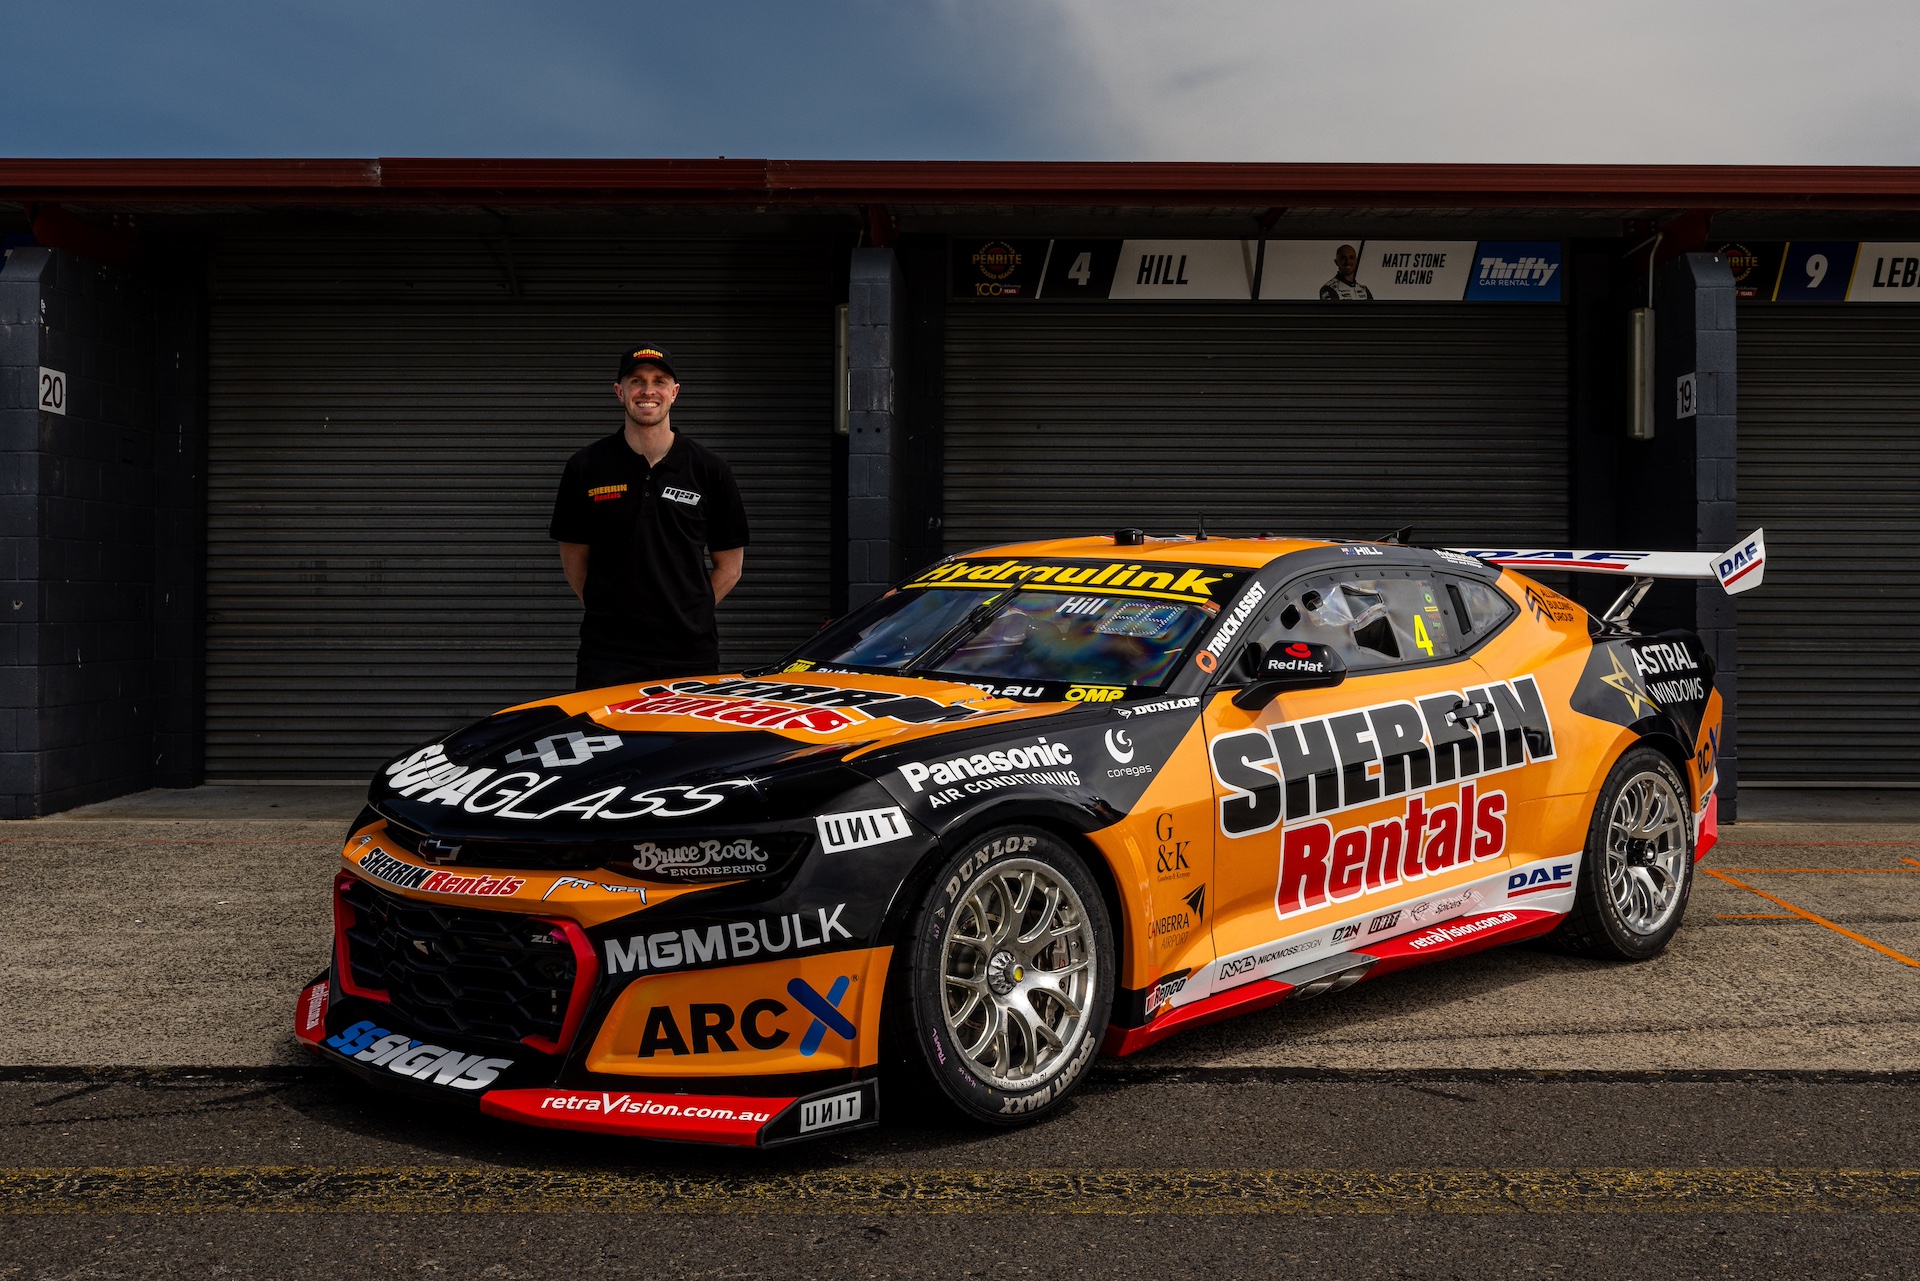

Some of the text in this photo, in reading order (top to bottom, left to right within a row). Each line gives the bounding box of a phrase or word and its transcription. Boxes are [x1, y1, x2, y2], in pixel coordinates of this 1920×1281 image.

[972, 254, 1022, 265] PENRITE
[1067, 252, 1092, 286] 4
[1137, 255, 1188, 285] HILL
[1382, 254, 1446, 268] MATT STONE
[1479, 257, 1559, 287] Thrifty
[1728, 256, 1758, 267] RITE
[1806, 253, 1829, 289] 9
[1873, 257, 1920, 288] LEB
[975, 283, 1002, 296] 100
[1395, 270, 1433, 285] RACING
[42, 374, 63, 409] 20
[1679, 380, 1692, 414] 19
[588, 484, 628, 497] SHERRIN
[1354, 546, 1383, 556] HILL
[1719, 542, 1758, 578] DAF
[915, 560, 1223, 597] Hydraulink
[1055, 597, 1109, 615] Hill
[1413, 614, 1435, 657] 4
[1268, 660, 1324, 672] Red Hat
[1631, 642, 1698, 677] ASTRAL
[1065, 688, 1125, 702] OMP
[1132, 696, 1200, 715] DUNLOP
[1646, 677, 1705, 704] WINDOWS
[898, 737, 1073, 792] Panasonic
[1211, 674, 1556, 838] SHERRIN
[386, 744, 748, 820] SUPAGLASS
[1107, 765, 1152, 778] coregas
[928, 770, 1081, 809] AIR CONDITIONING
[824, 812, 899, 847] UNIT
[1156, 812, 1174, 842] G
[632, 839, 769, 870] Bruce Rock
[1276, 781, 1508, 919] Rentals
[358, 847, 526, 896] SHERRIN Rentals
[670, 864, 767, 877] ENGINEERING
[946, 836, 1038, 904] DUNLOP
[1508, 864, 1573, 890] DAF
[604, 903, 852, 974] MGMBULK
[1148, 912, 1190, 939] CANBERRA
[1160, 931, 1190, 950] AIRPORT
[1409, 911, 1518, 949] retraVision.com.au
[638, 975, 857, 1058] ARCX
[1054, 1030, 1096, 1098] SPORT
[541, 1093, 769, 1122] retraVision.com.au
[805, 1097, 857, 1127] UNIT
[999, 1086, 1052, 1114] MAXX
